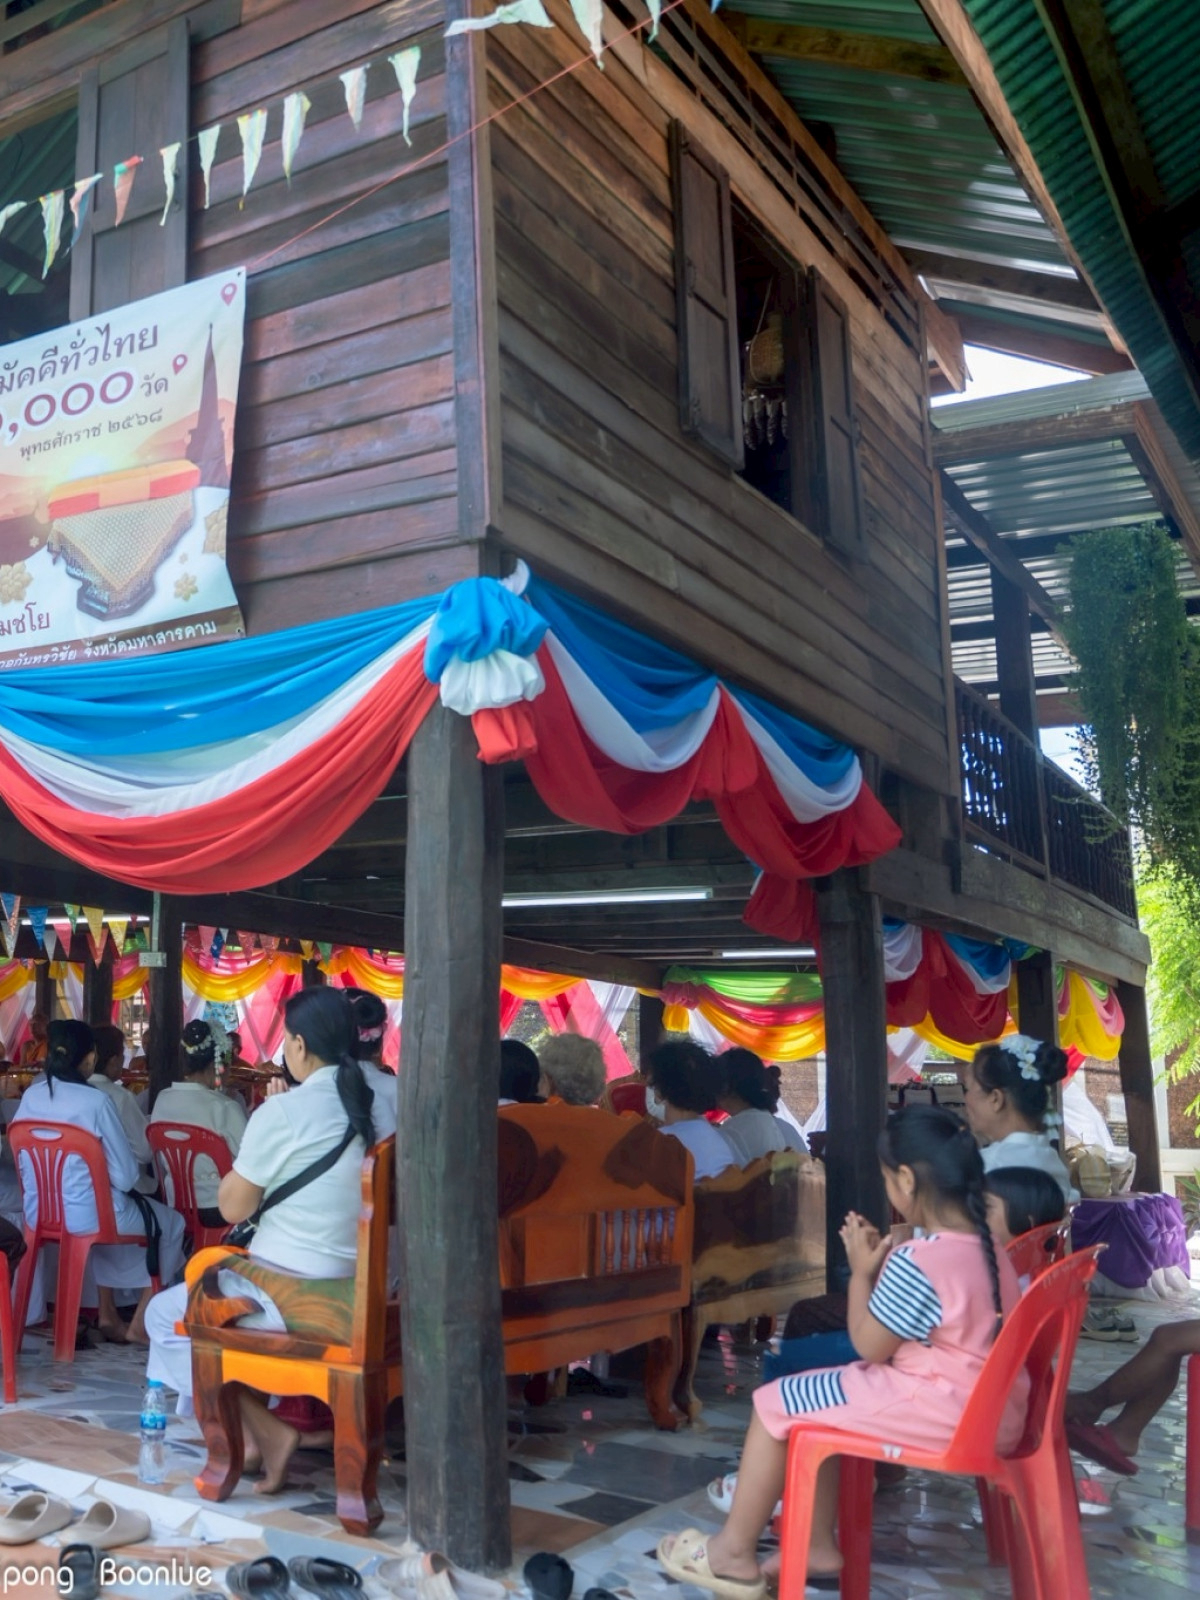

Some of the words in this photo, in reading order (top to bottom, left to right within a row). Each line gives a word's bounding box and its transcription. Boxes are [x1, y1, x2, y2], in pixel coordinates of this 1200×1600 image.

[140, 372, 169, 398] วัด
[19, 423, 102, 461] พุทธศักราช
[108, 408, 163, 433] ๒๕๖๘
[83, 619, 217, 658] จังหวัดมหาสารคาม
